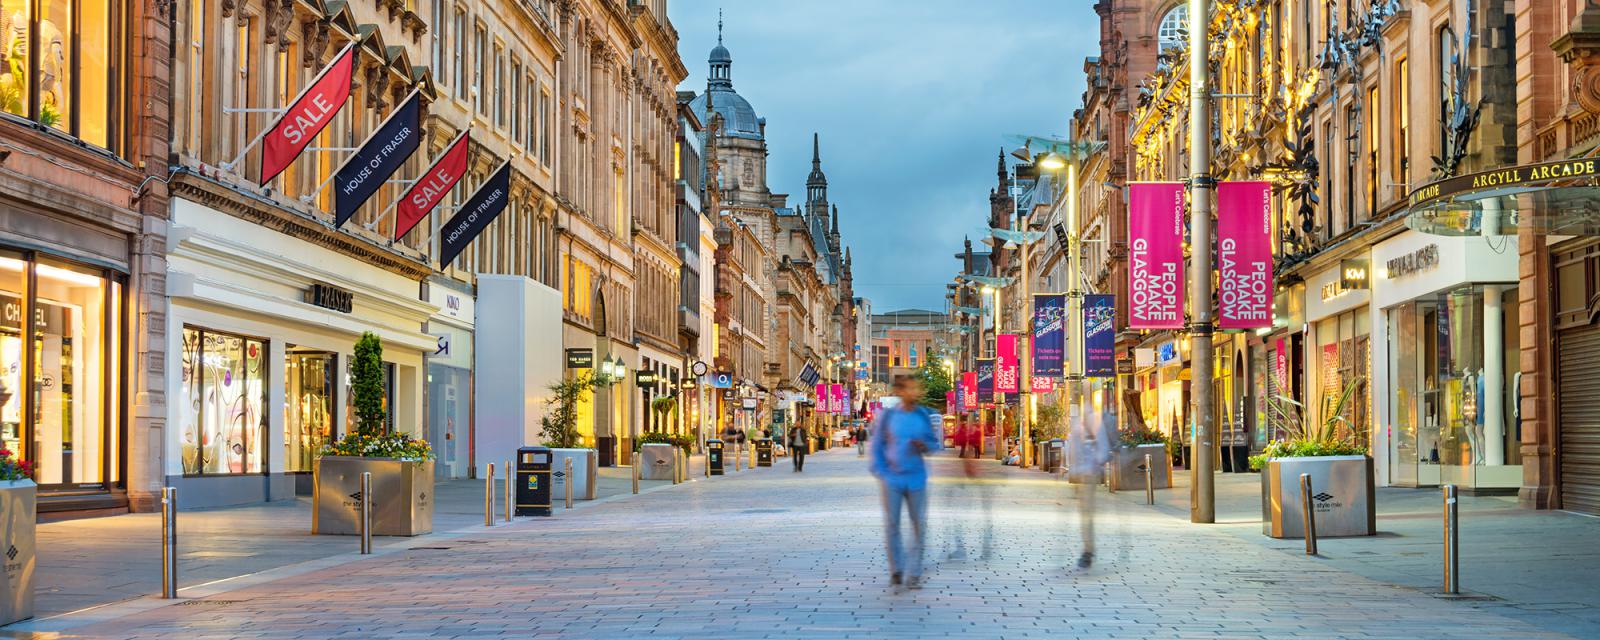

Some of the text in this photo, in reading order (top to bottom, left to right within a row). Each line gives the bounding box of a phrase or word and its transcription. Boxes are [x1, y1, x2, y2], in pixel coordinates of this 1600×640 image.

[283, 93, 334, 145] SALE
[343, 127, 412, 196] HOUSE OF FRASER
[1472, 161, 1595, 188] ARGYLL ARCADE
[412, 168, 454, 209] SALE
[446, 188, 503, 244] HOUSE OF FRASER
[1133, 238, 1147, 320] GLASGOW
[1148, 275, 1162, 320] MAKE
[1162, 262, 1176, 320] PEOPLE
[1221, 238, 1236, 320] GLASGOW
[1237, 274, 1252, 320] MAKE
[1252, 262, 1266, 320] PEOPLE
[1345, 268, 1365, 280] KM
[1036, 320, 1062, 338] GLASGOW
[1086, 319, 1112, 338] GLASGOW
